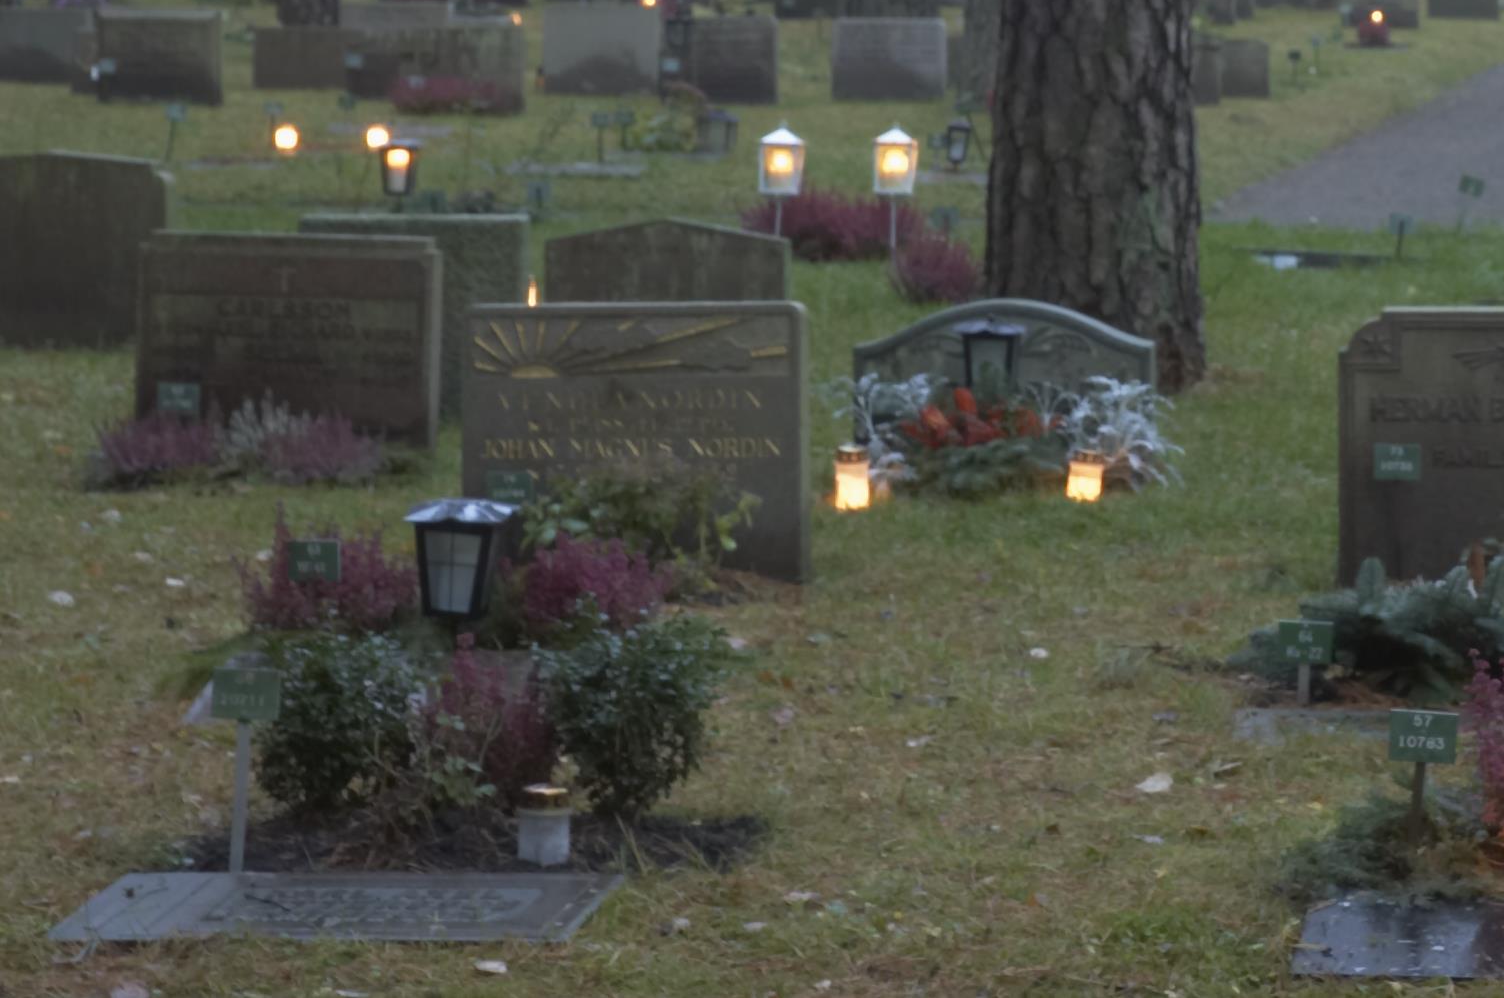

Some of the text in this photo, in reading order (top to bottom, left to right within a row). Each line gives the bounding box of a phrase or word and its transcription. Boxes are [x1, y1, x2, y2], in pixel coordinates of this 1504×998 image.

[217, 298, 350, 318] CARLSSON
[1370, 396, 1481, 422] HERMAN
[481, 438, 554, 458] JOHAN
[684, 438, 782, 458] NORDIN
[1413, 713, 1433, 728] 57
